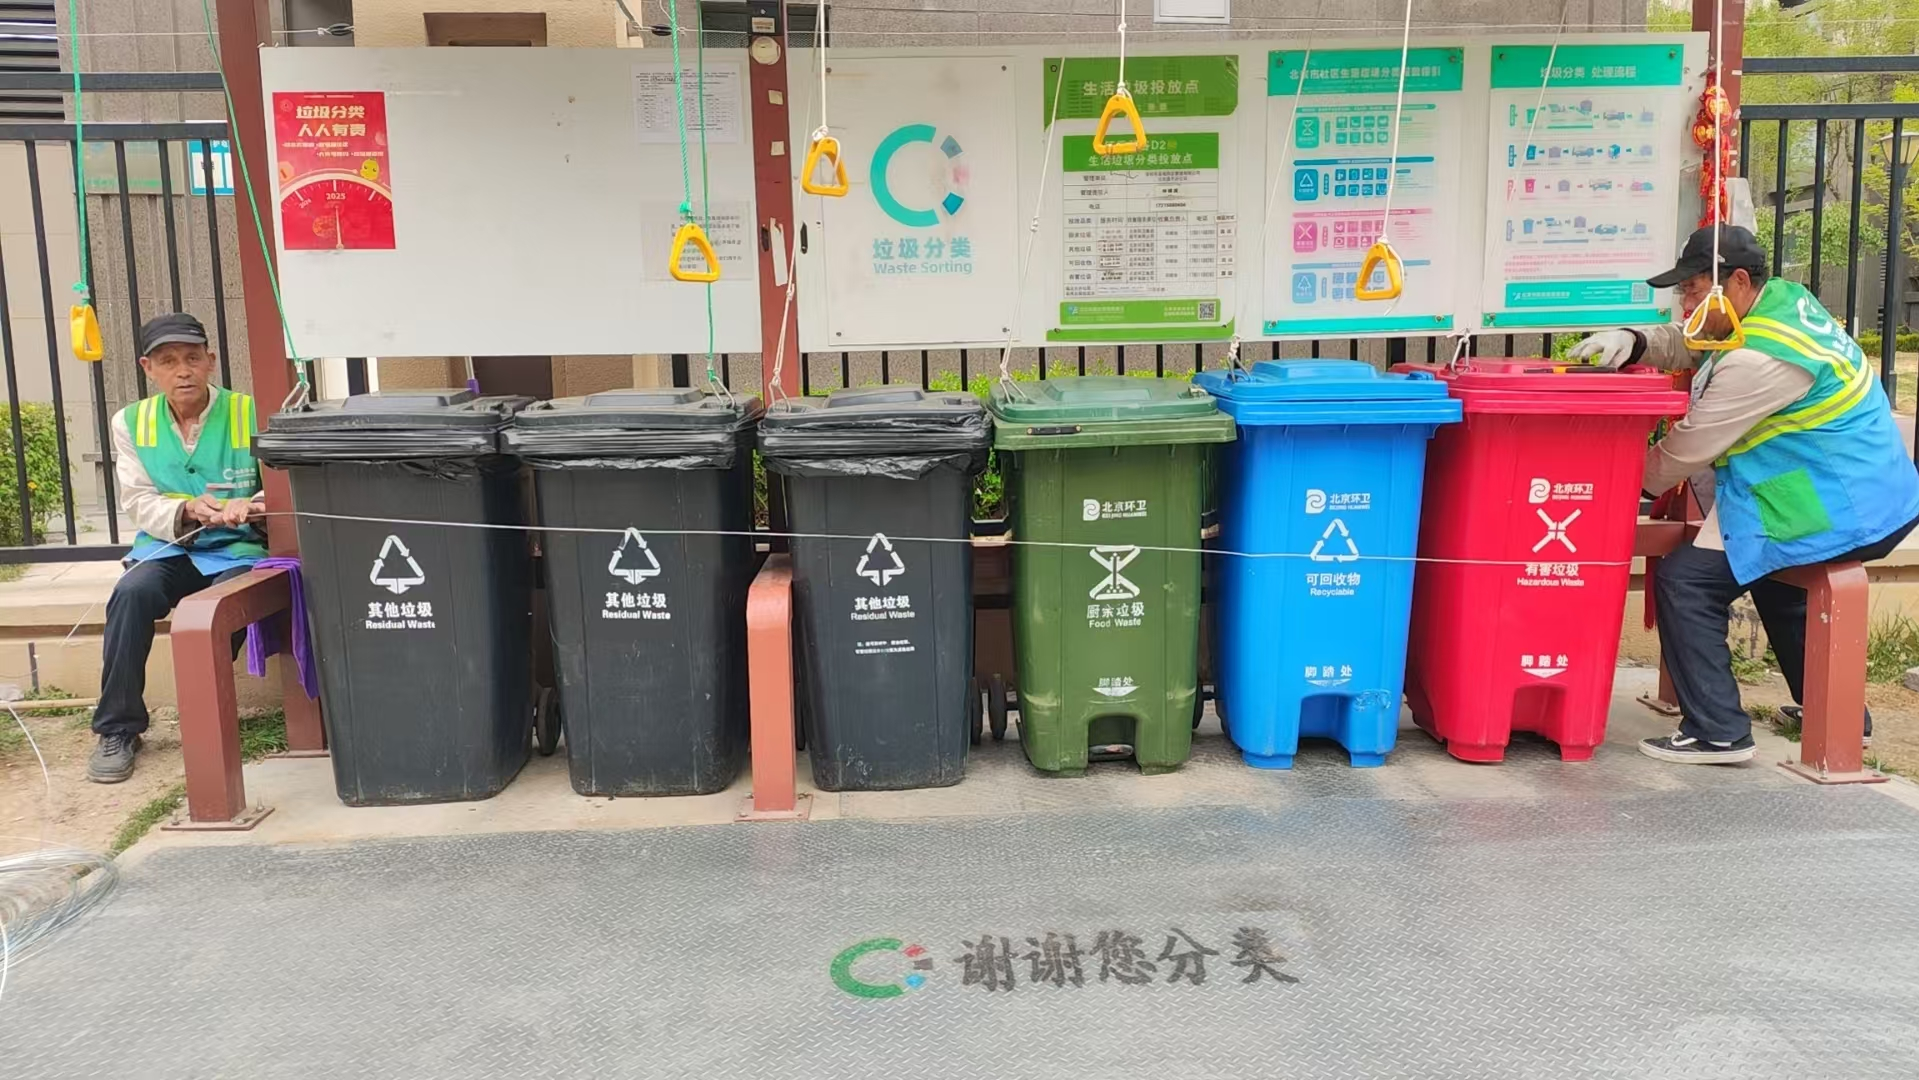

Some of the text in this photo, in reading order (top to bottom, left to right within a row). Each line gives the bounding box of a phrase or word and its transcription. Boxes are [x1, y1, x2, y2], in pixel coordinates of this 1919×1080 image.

[296, 105, 365, 119] 垃圾分类
[298, 124, 366, 137] 人人有责
[1089, 153, 1193, 167] 生活垃圾分类投放点
[873, 237, 971, 260] 垃圾分类
[873, 261, 973, 275] Waste Sorting
[1553, 483, 1593, 494] 北京环卫
[1330, 493, 1370, 504] 北京环卫
[1102, 500, 1147, 512] 北京环卫
[1525, 562, 1579, 577] 有害垃圾
[1306, 572, 1361, 586] 可回收物
[1516, 577, 1560, 586] Hazardous
[1310, 587, 1355, 598] Recyclable
[605, 592, 667, 608] 其他垃圾
[854, 595, 911, 611] 其他垃圾
[368, 601, 433, 618] 其他垃圾
[602, 609, 671, 620] Residual Waste
[850, 610, 915, 621] Residual Waste
[1086, 602, 1145, 619] 厨余垃圾
[365, 620, 406, 629] Residual
[1089, 618, 1142, 629] Food Waste
[1520, 655, 1569, 667] 脚踏处
[1304, 665, 1353, 678] 脚踏处
[1098, 676, 1134, 687] 脚踏处
[954, 927, 1300, 993] 谢谢您分类
